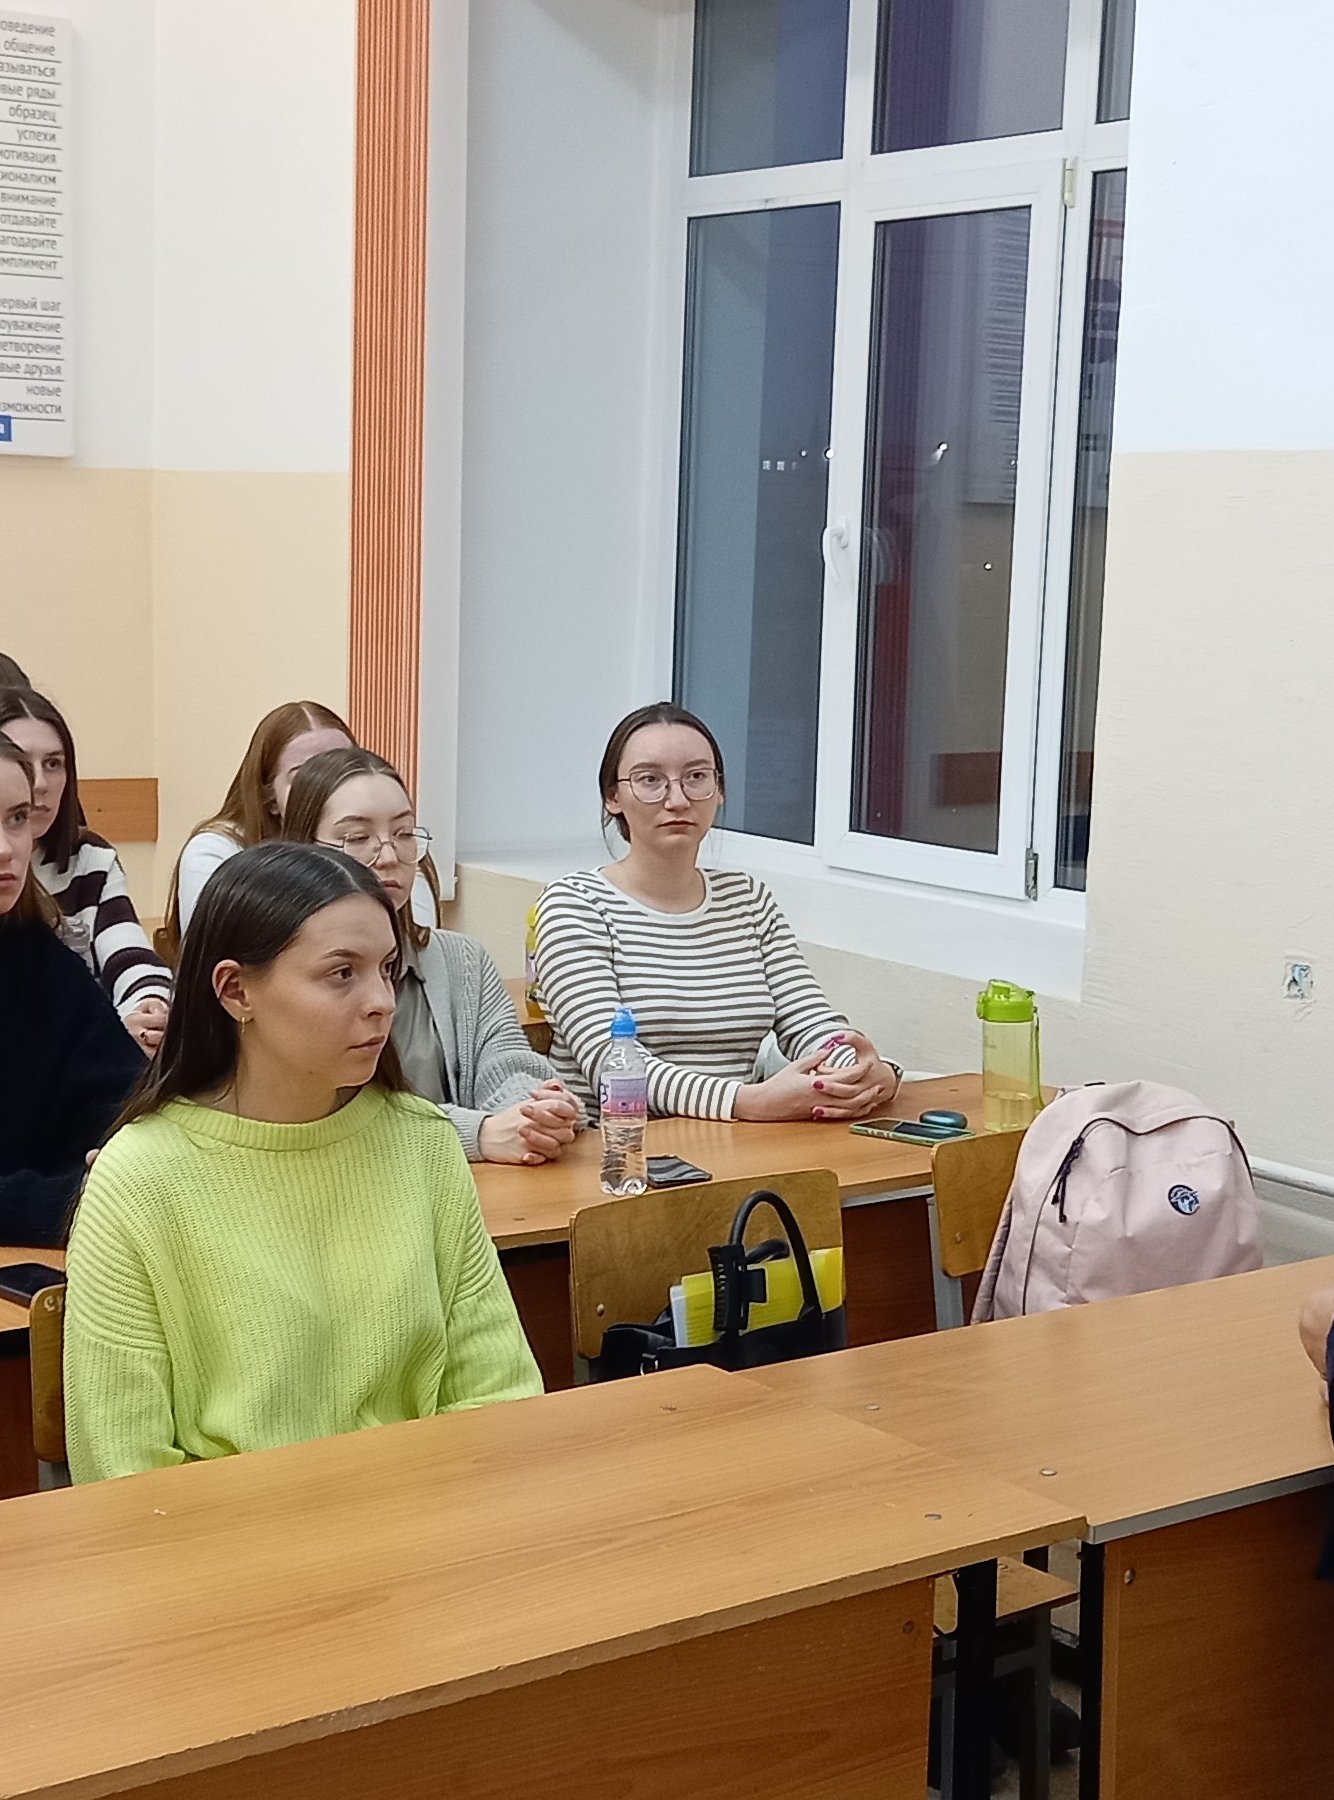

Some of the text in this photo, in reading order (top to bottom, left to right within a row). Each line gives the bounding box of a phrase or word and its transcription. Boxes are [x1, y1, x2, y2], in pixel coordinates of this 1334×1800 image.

[2, 38, 56, 55] общение
[26, 85, 57, 102] ряды
[8, 105, 57, 123] образец
[17, 131, 57, 144] успехи
[0, 192, 57, 208] внимание
[0, 213, 58, 229] отдавайте
[41, 298, 61, 312] шаг
[23, 363, 62, 379] друзья
[26, 385, 62, 398] новые
